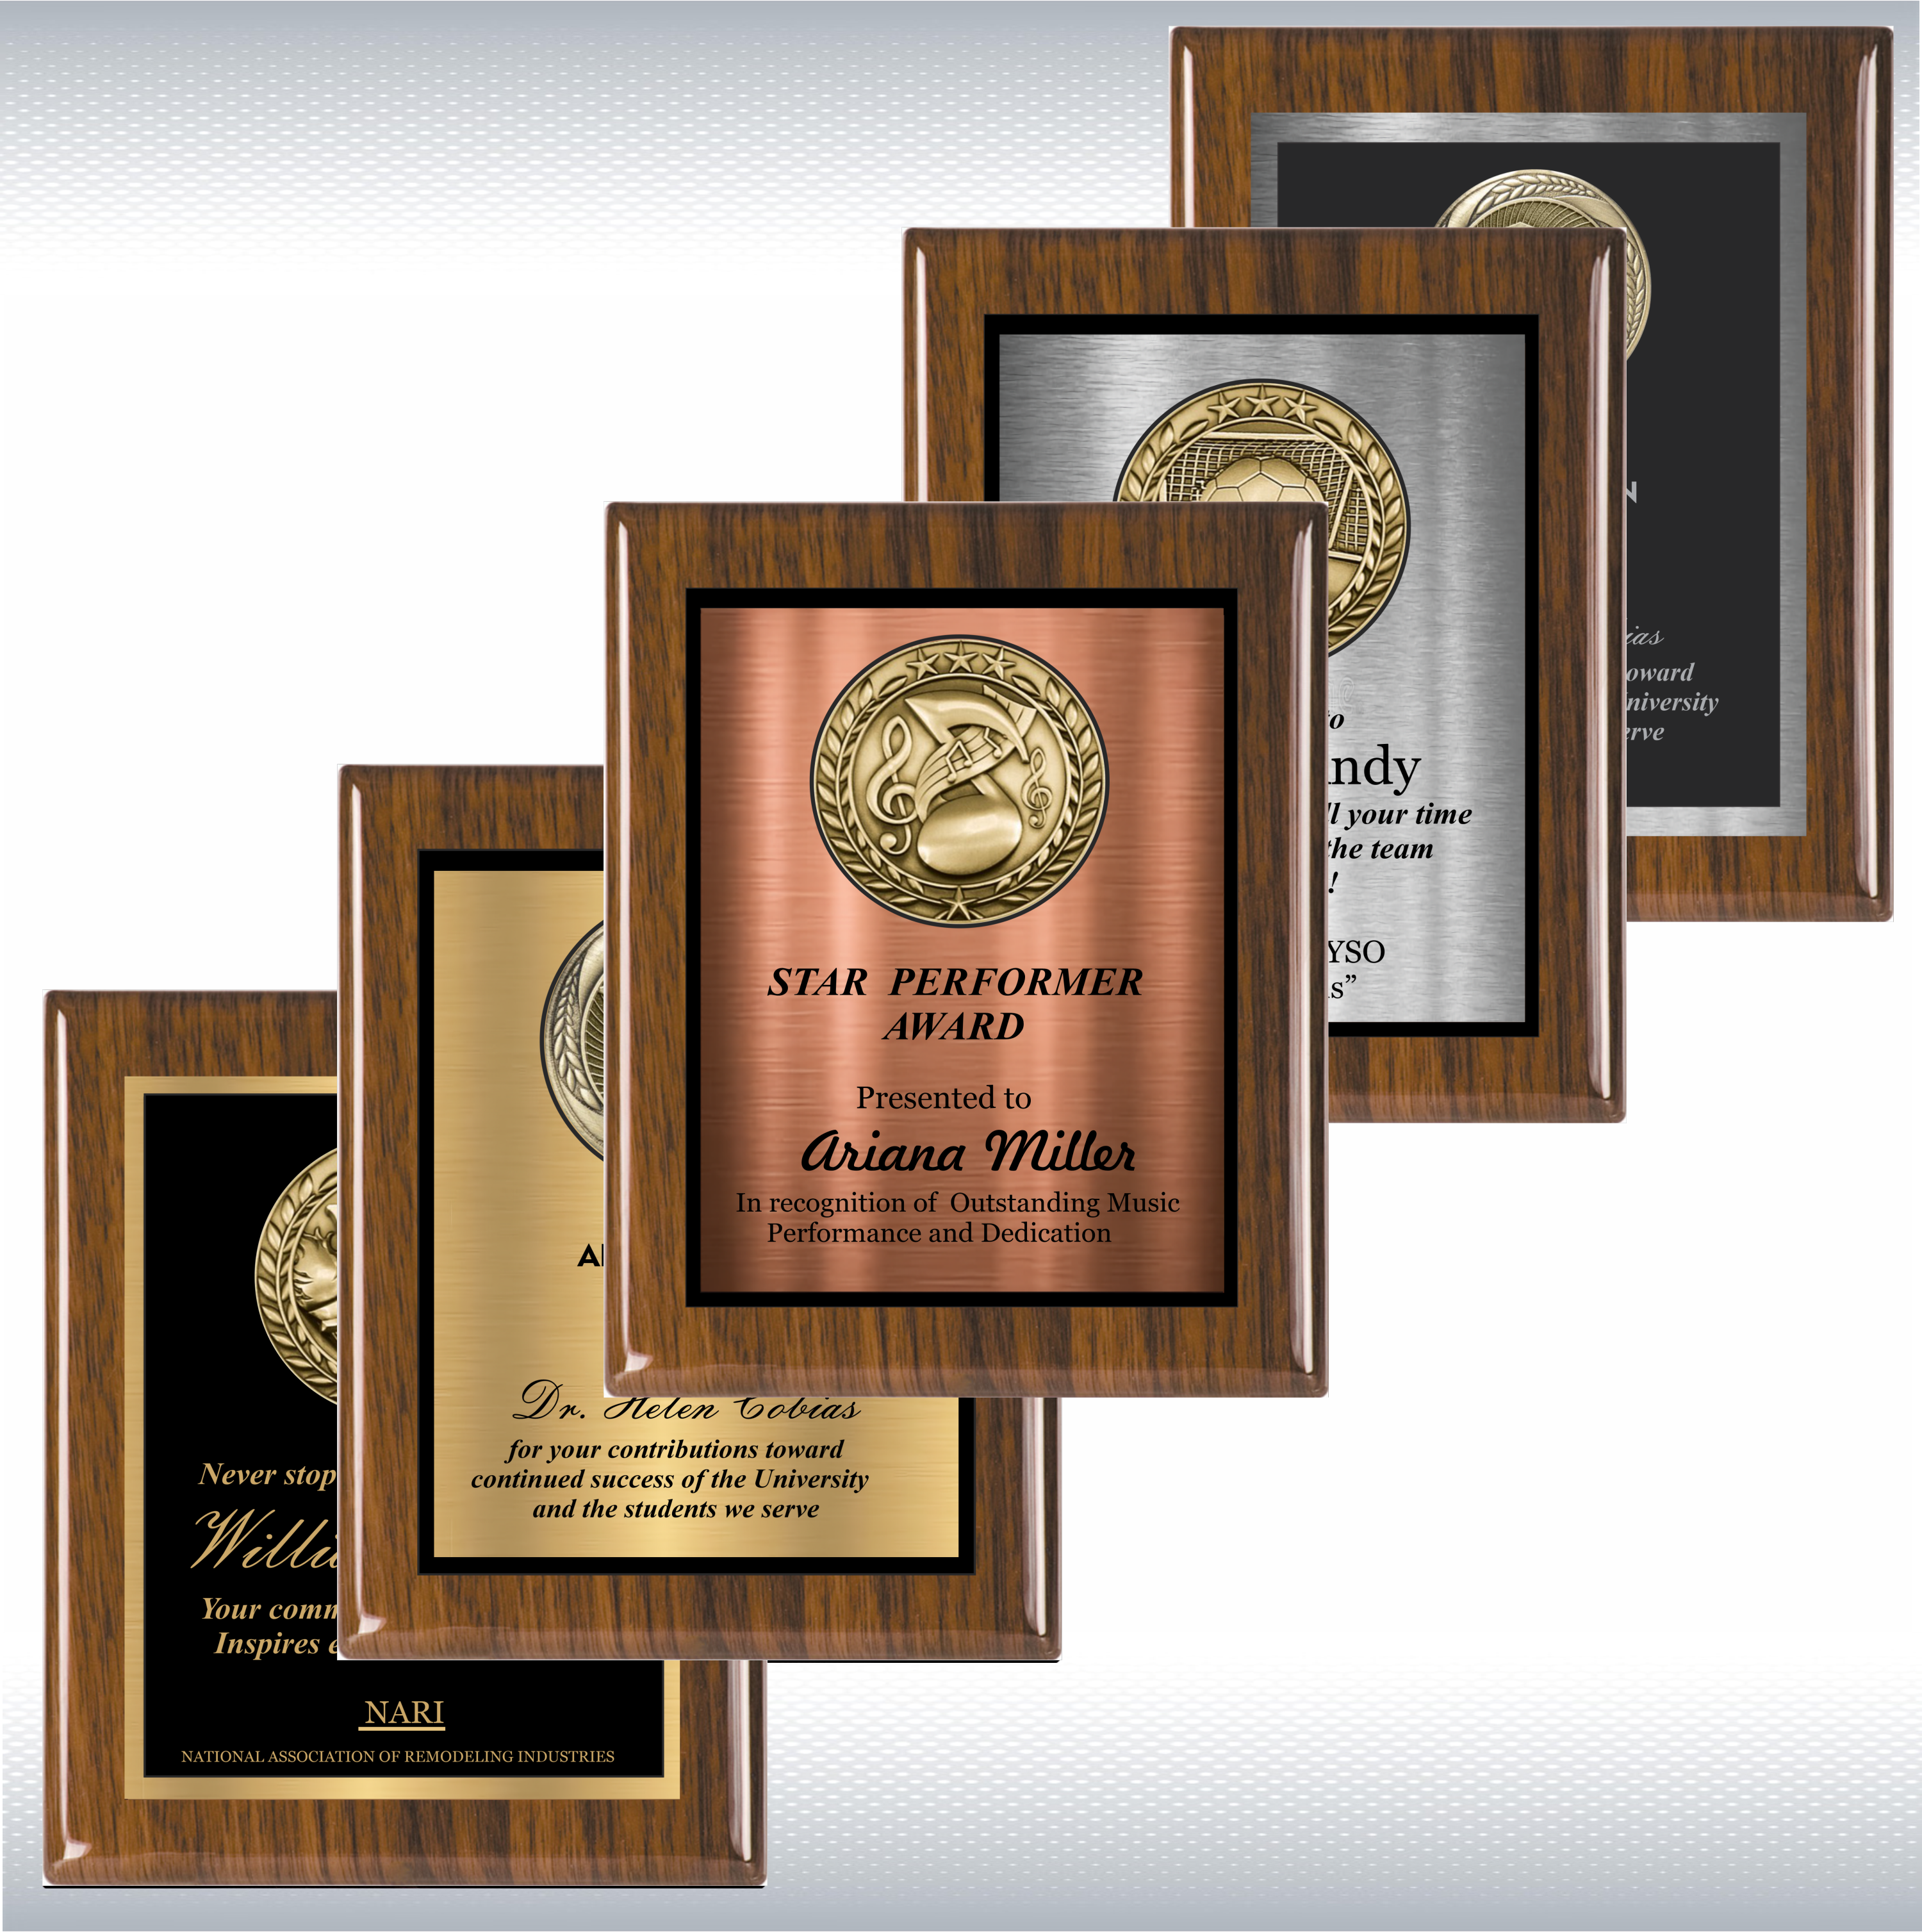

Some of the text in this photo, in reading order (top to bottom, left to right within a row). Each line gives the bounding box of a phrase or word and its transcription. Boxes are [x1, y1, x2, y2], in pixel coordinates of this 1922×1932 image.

[1344, 810, 1408, 830] your
[1417, 803, 1472, 824] time
[1372, 841, 1433, 859] team
[768, 968, 1142, 995] STAR PERFORMER
[882, 1012, 1024, 1040] AWARD
[857, 1085, 1031, 1109] Presented to
[801, 1130, 1135, 1171] Ariana Miller
[737, 1191, 1179, 1218] In recognition of Outstanding Music
[768, 1222, 1112, 1242] Performance and Dedication
[513, 1380, 584, 1419] Dr.
[504, 1440, 844, 1464] for your contributions toward
[198, 1464, 336, 1490] Never stop
[472, 1469, 869, 1493] continued success of the University
[533, 1499, 819, 1517] and the students we serve
[202, 1598, 261, 1619] Your
[213, 1632, 320, 1660] Inspires
[365, 1701, 443, 1723] NARI
[182, 1751, 614, 1762] NATIONAL ASSOCIATION OF REMODELING INDUSTRIES
